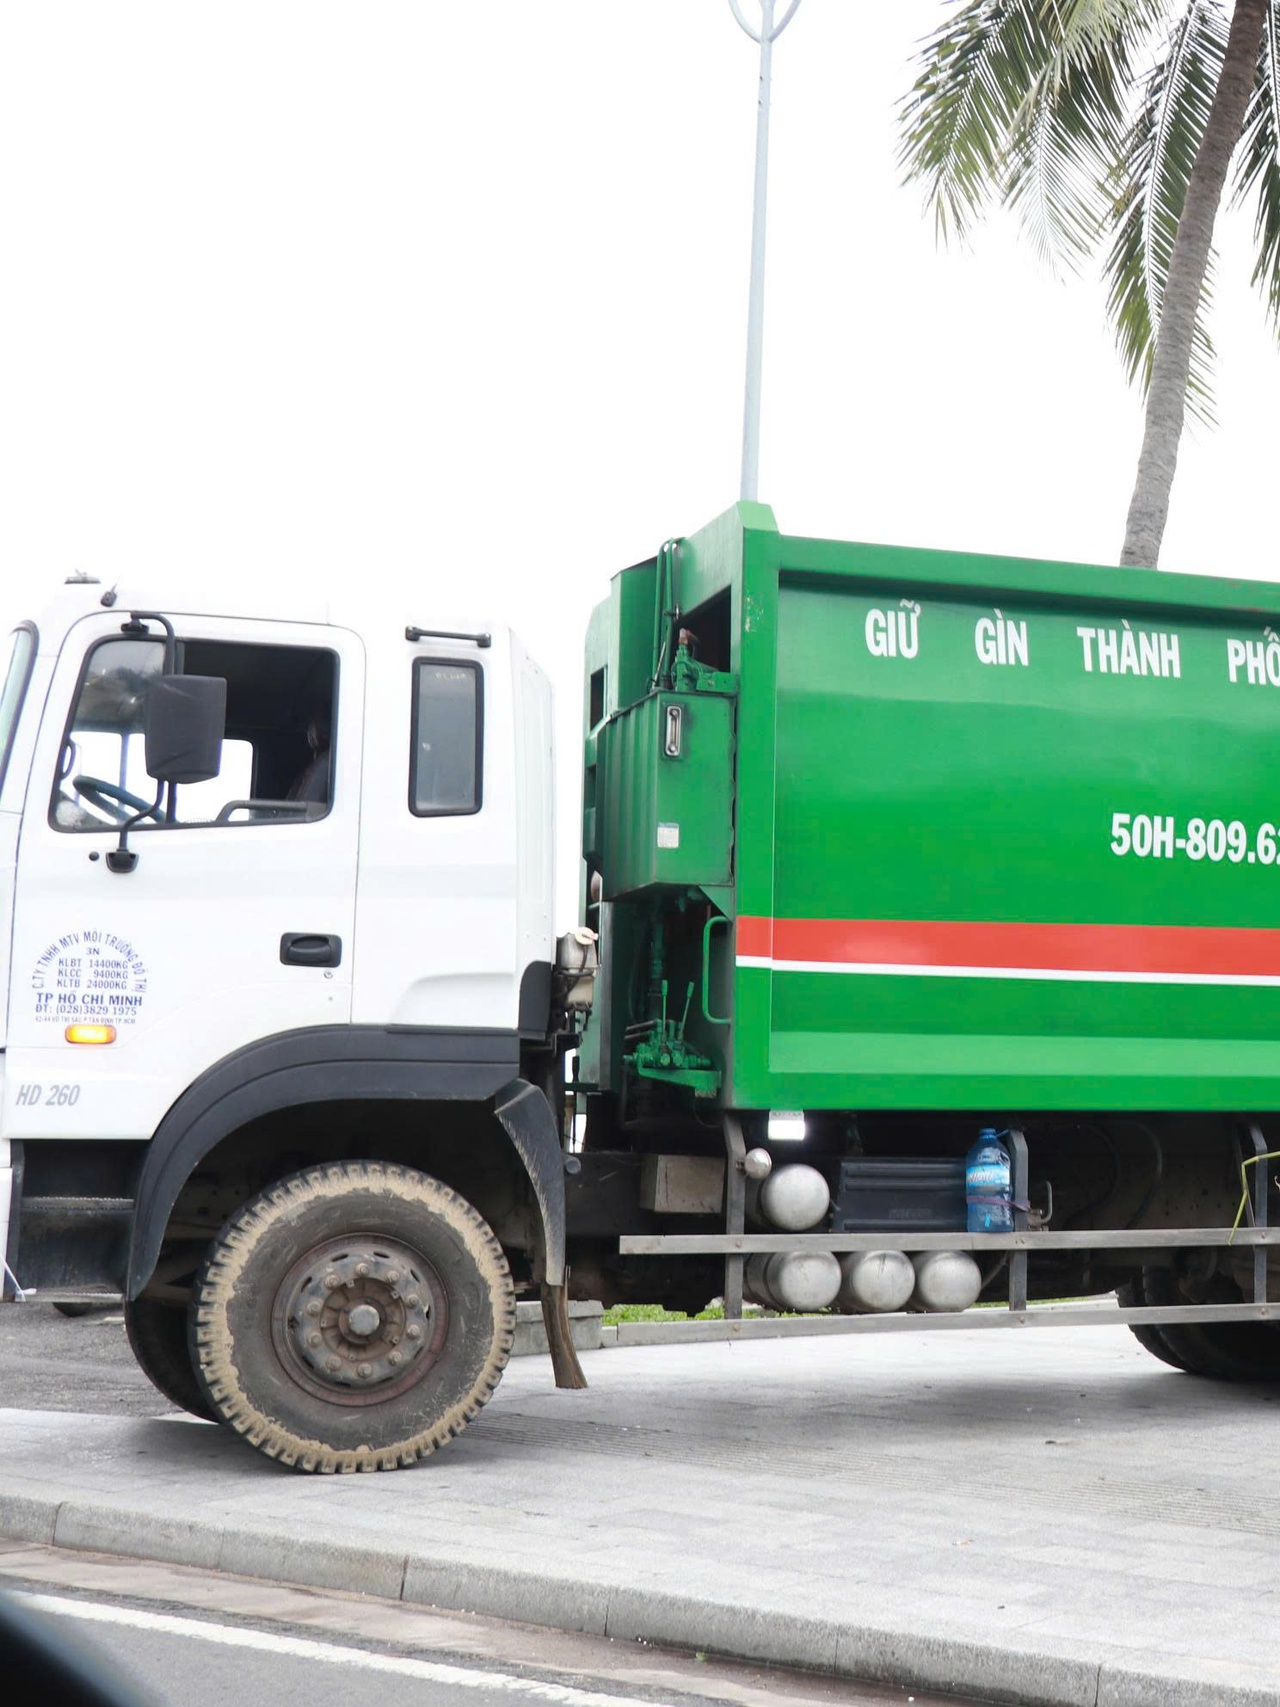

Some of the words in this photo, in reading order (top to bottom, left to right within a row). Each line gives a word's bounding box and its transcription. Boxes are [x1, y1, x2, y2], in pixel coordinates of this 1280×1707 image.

[865, 598, 921, 658] GIỮ
[975, 608, 1029, 666] GÌN
[1077, 618, 1181, 678] THÀNH
[59, 933, 79, 948] MTV
[58, 958, 82, 967] KLBT
[89, 959, 129, 969] 14400KG
[58, 968, 81, 978] KLCC
[94, 969, 129, 979] 9400KG
[57, 979, 80, 988] KLTB
[86, 980, 127, 990] 24000KG
[36, 992, 53, 1003] TP
[108, 995, 142, 1006] MINH
[16, 1084, 42, 1106] HD
[45, 1084, 80, 1106] 260
